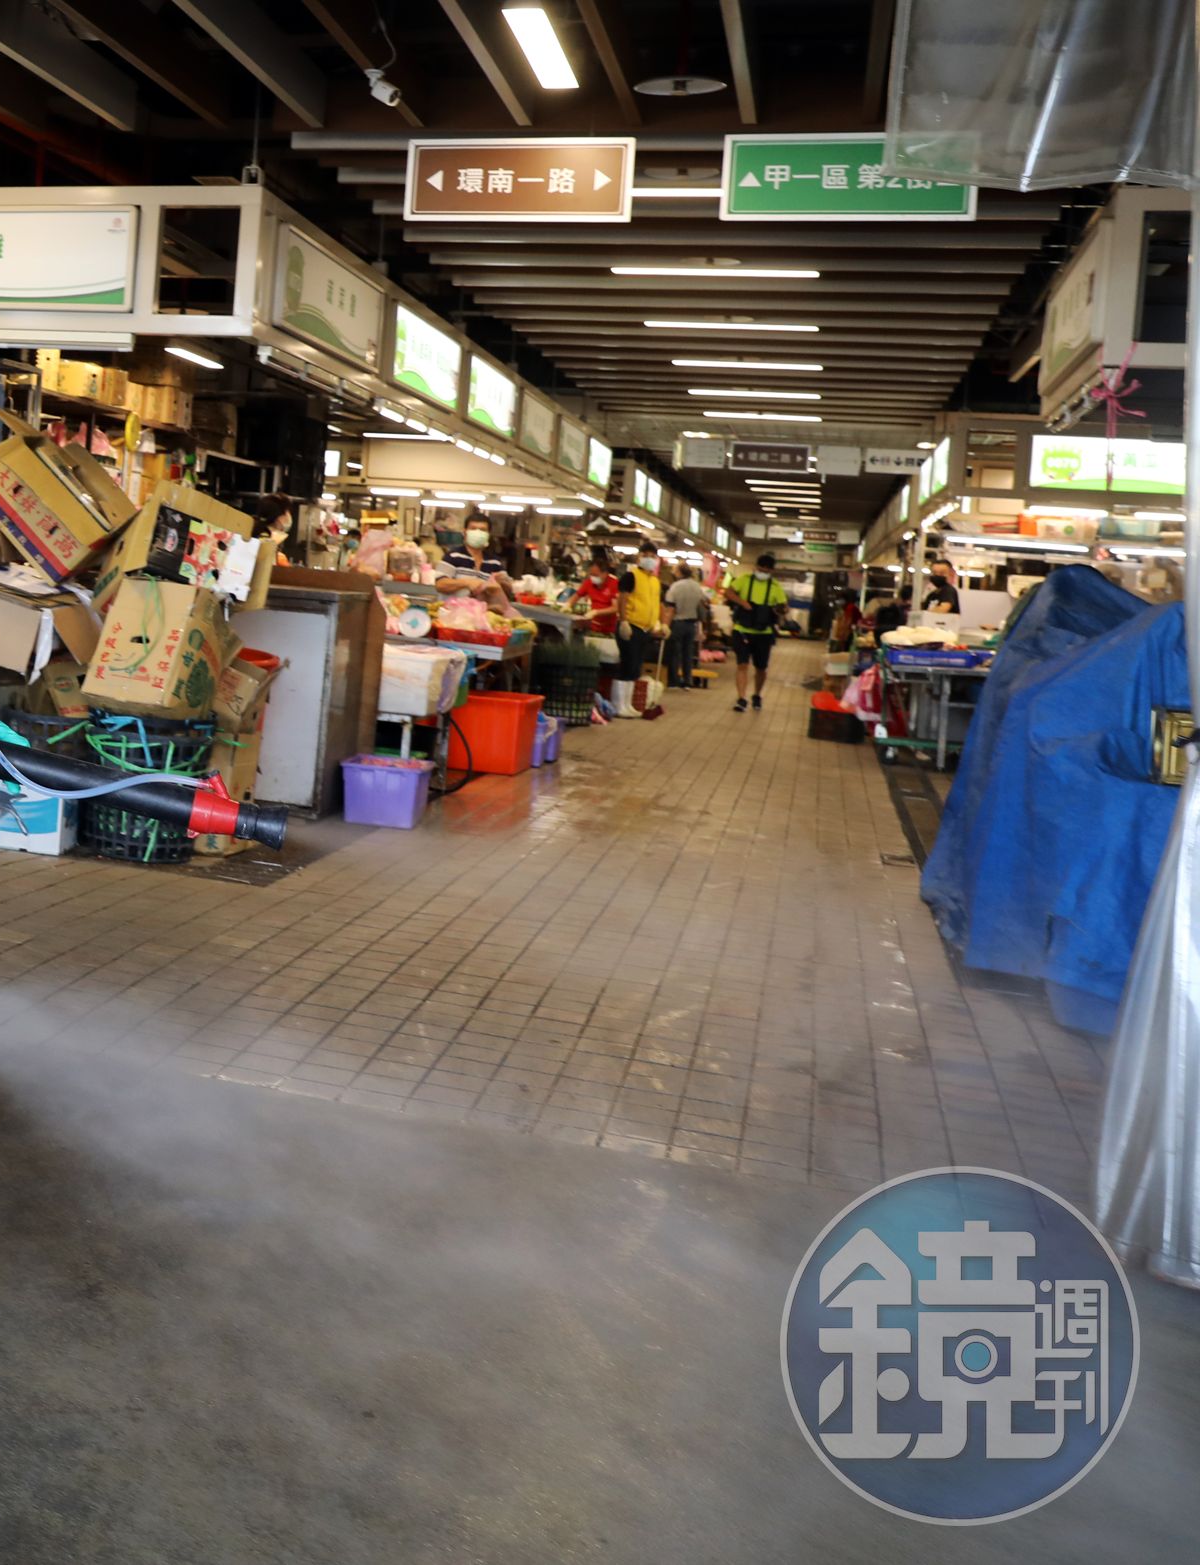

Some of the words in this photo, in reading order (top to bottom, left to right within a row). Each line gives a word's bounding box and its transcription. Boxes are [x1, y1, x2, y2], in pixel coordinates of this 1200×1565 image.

[456, 167, 576, 194] 環南一路
[763, 164, 850, 190] 甲一區
